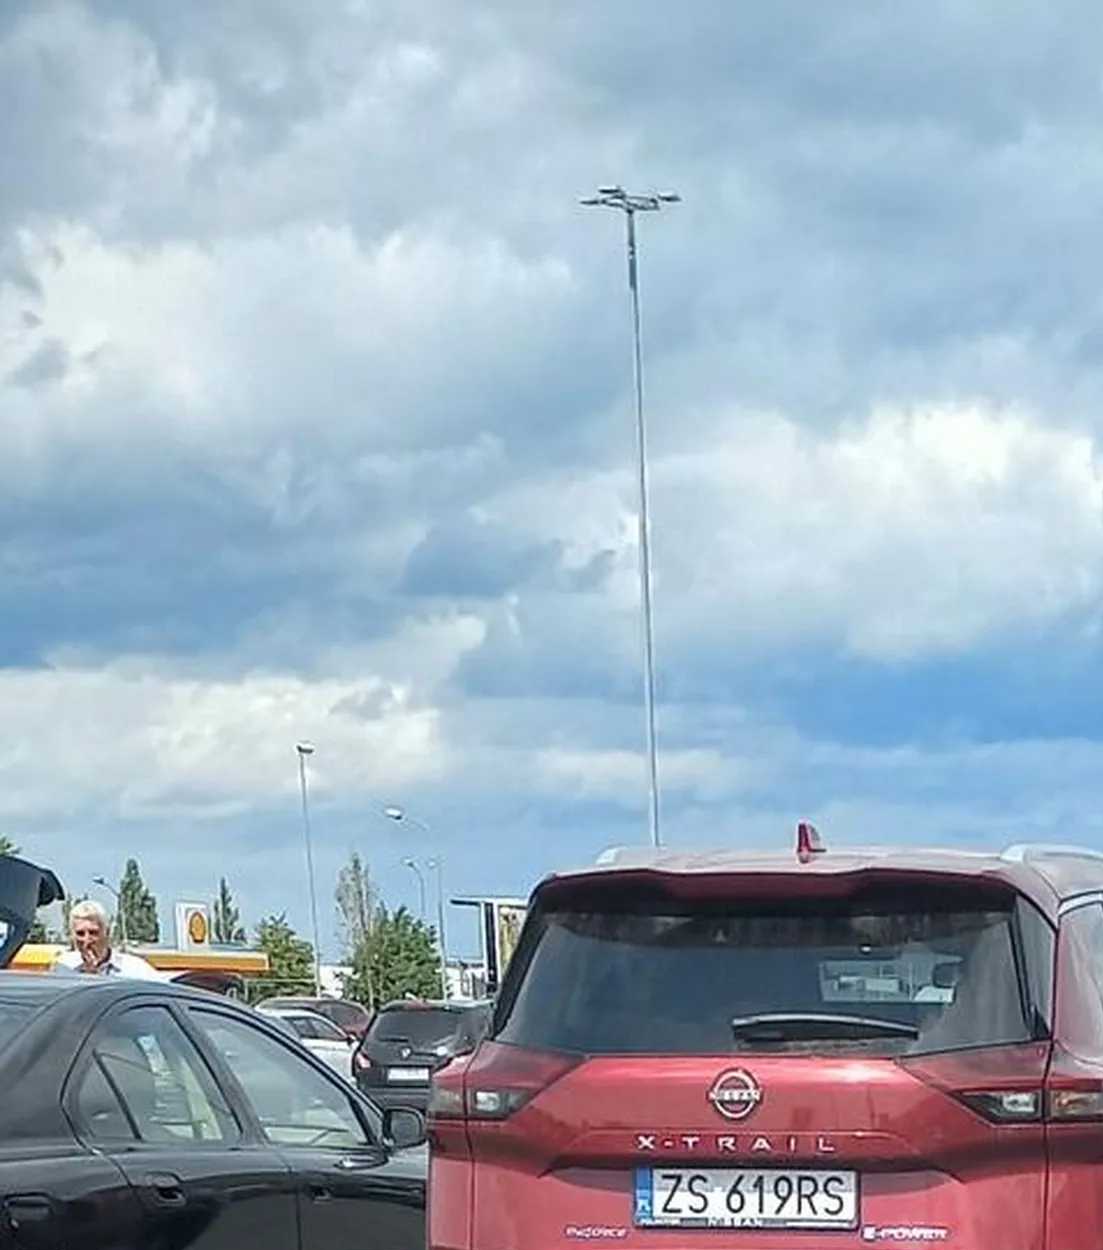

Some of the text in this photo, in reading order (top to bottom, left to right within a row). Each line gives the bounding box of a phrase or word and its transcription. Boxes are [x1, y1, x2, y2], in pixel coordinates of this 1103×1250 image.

[637, 1136, 835, 1151] X-TRAIL
[661, 1174, 708, 1214] ZS
[726, 1174, 845, 1215] 619RS
